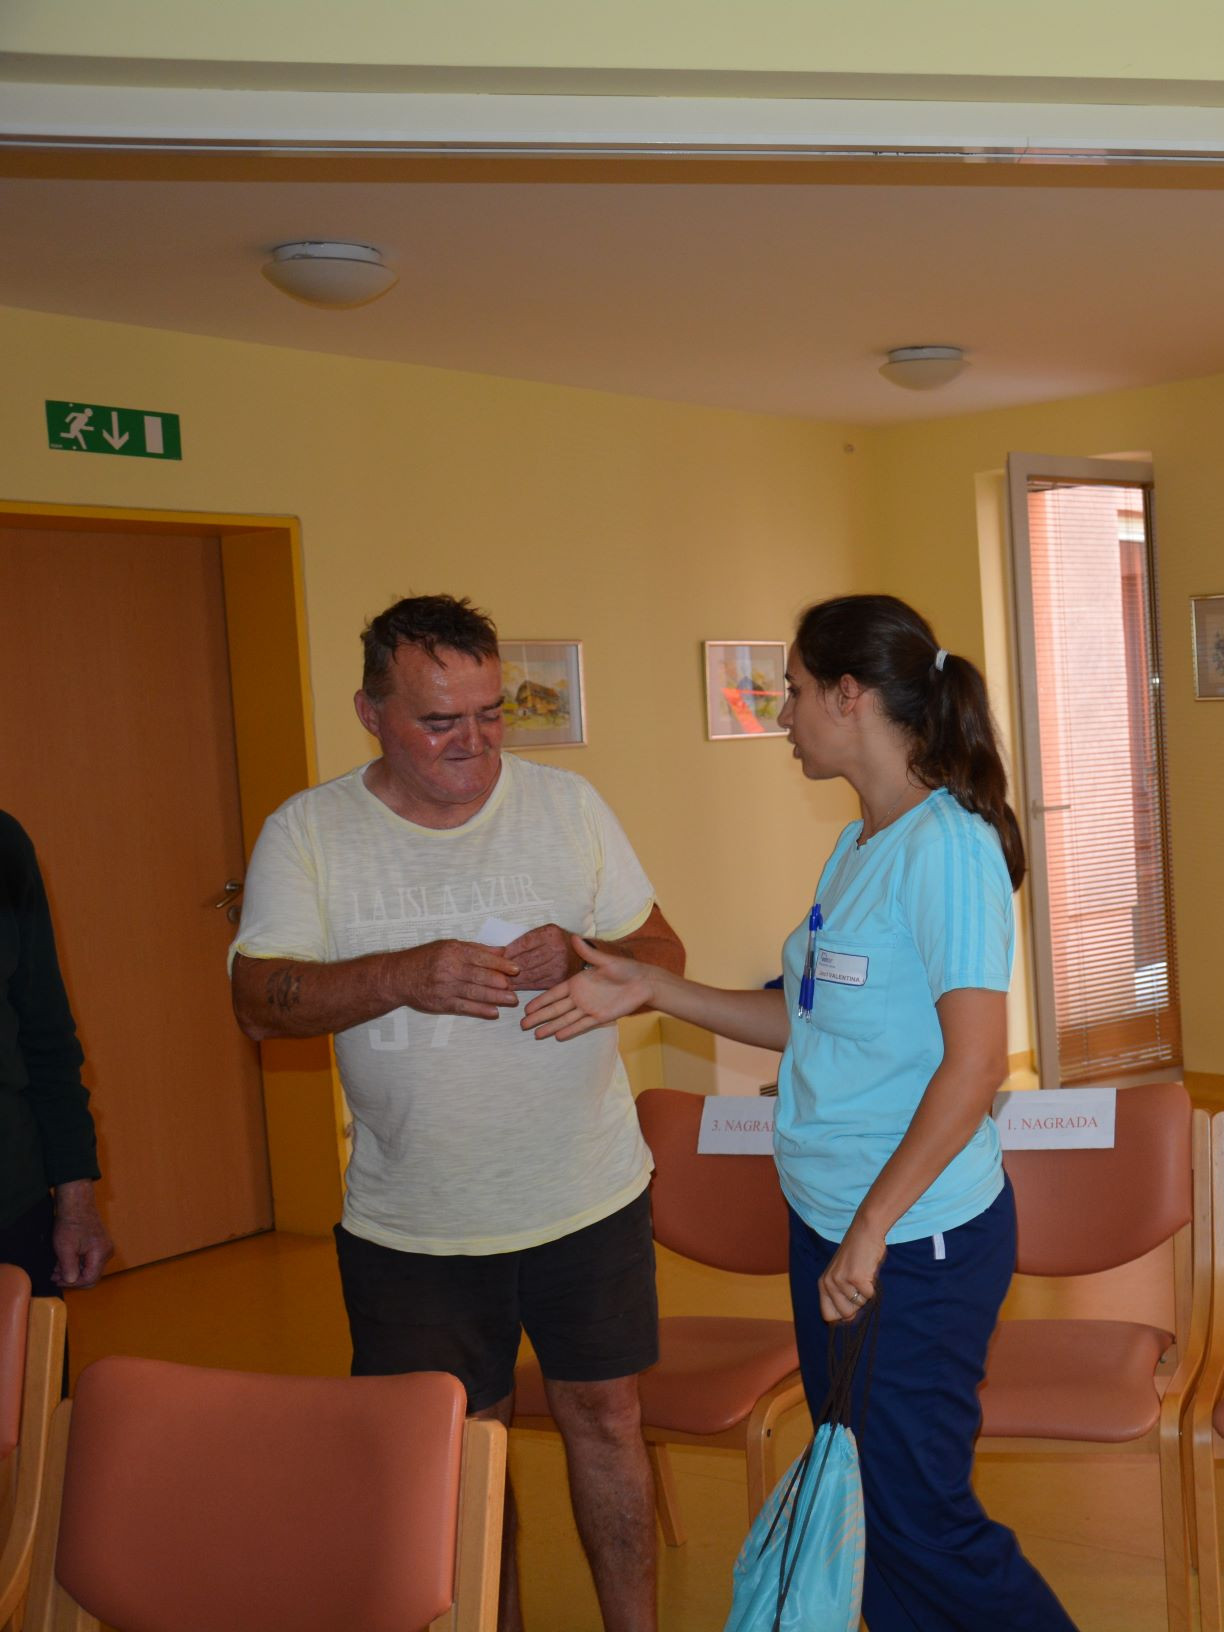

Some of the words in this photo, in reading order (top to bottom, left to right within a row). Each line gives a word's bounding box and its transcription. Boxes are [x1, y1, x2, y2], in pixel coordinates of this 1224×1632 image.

[711, 1119, 720, 1132] 3.
[724, 1119, 775, 1133] NAGRA
[1021, 1116, 1099, 1131] NAGRADA
